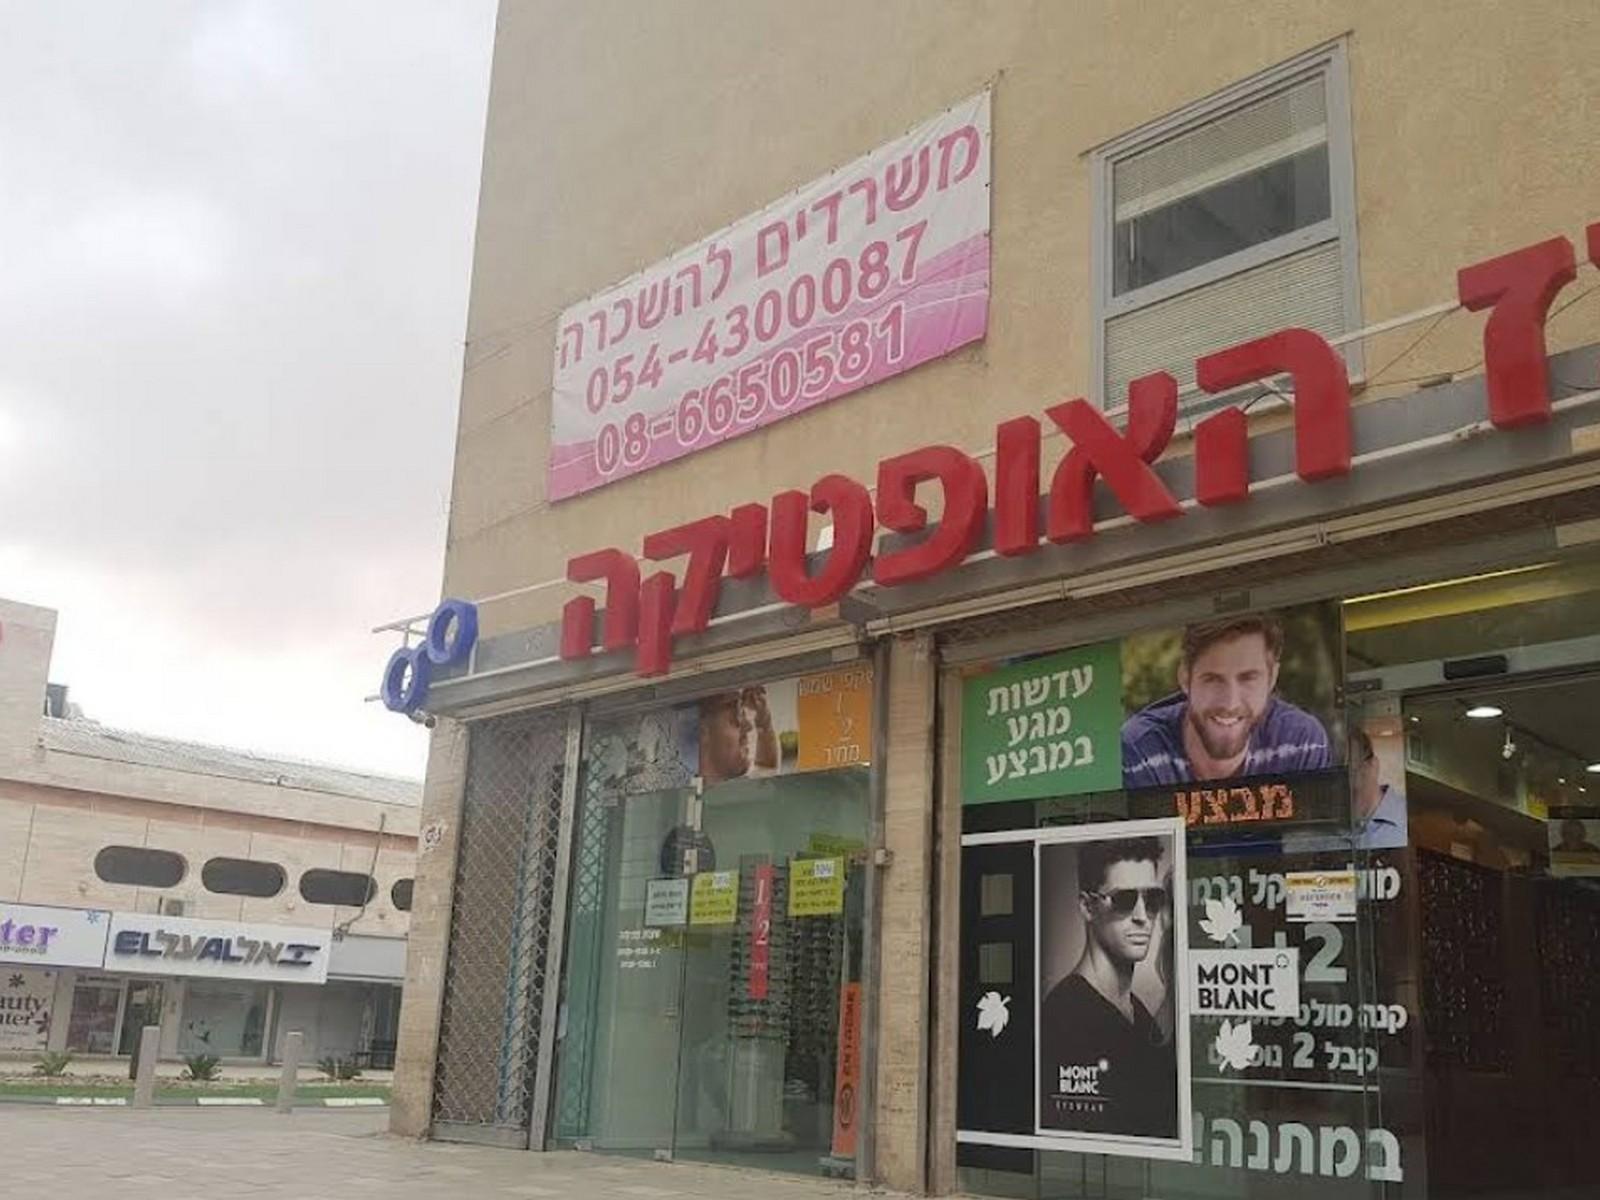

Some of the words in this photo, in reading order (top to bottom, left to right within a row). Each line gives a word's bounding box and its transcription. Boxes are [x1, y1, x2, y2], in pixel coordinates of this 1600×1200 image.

[756, 124, 981, 278] משרדים
[559, 243, 733, 369] להשכרה
[586, 219, 928, 414] 054-4300087
[1457, 222, 1600, 432] ז
[596, 301, 905, 475] 08-6650581
[560, 327, 1352, 678] האופטיקה
[987, 665, 1093, 716] עדשות
[1006, 706, 1071, 747] מגע
[986, 736, 1094, 785] במבצע
[1175, 784, 1293, 826] מבצע
[1198, 963, 1275, 985] MONT
[1198, 987, 1275, 1010] BLANC
[1359, 1004, 1408, 1034] קנה
[1293, 1032, 1315, 1068] 2
[1325, 1041, 1378, 1076] קבל
[1059, 1065, 1099, 1079] MONT
[1059, 1079, 1099, 1095] BLANC
